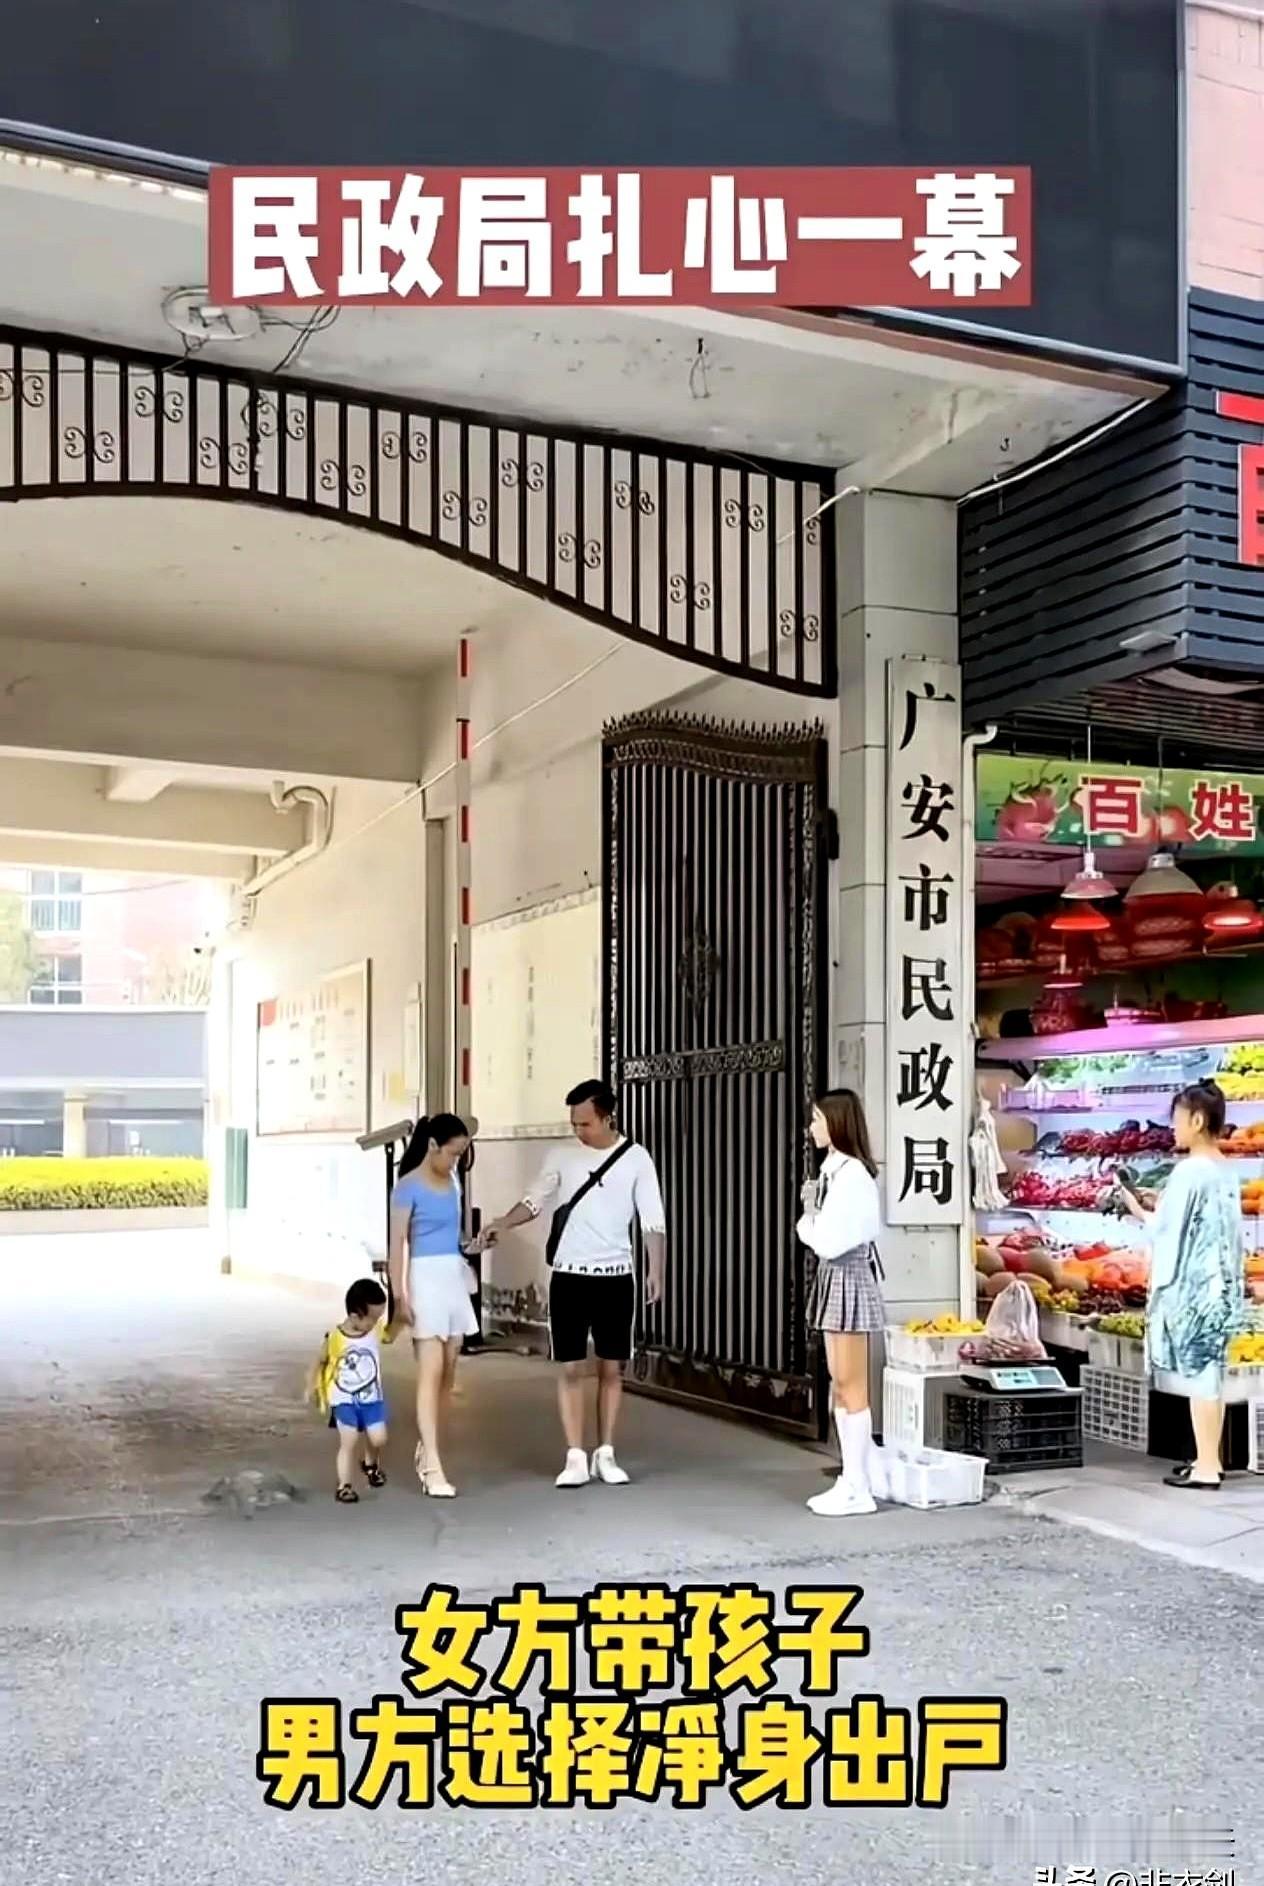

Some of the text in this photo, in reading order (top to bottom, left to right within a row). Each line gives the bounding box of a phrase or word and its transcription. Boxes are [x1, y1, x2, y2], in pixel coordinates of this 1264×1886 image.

[897, 682, 956, 1206] 广安市民政局
[1079, 774, 1256, 842] 百姓
